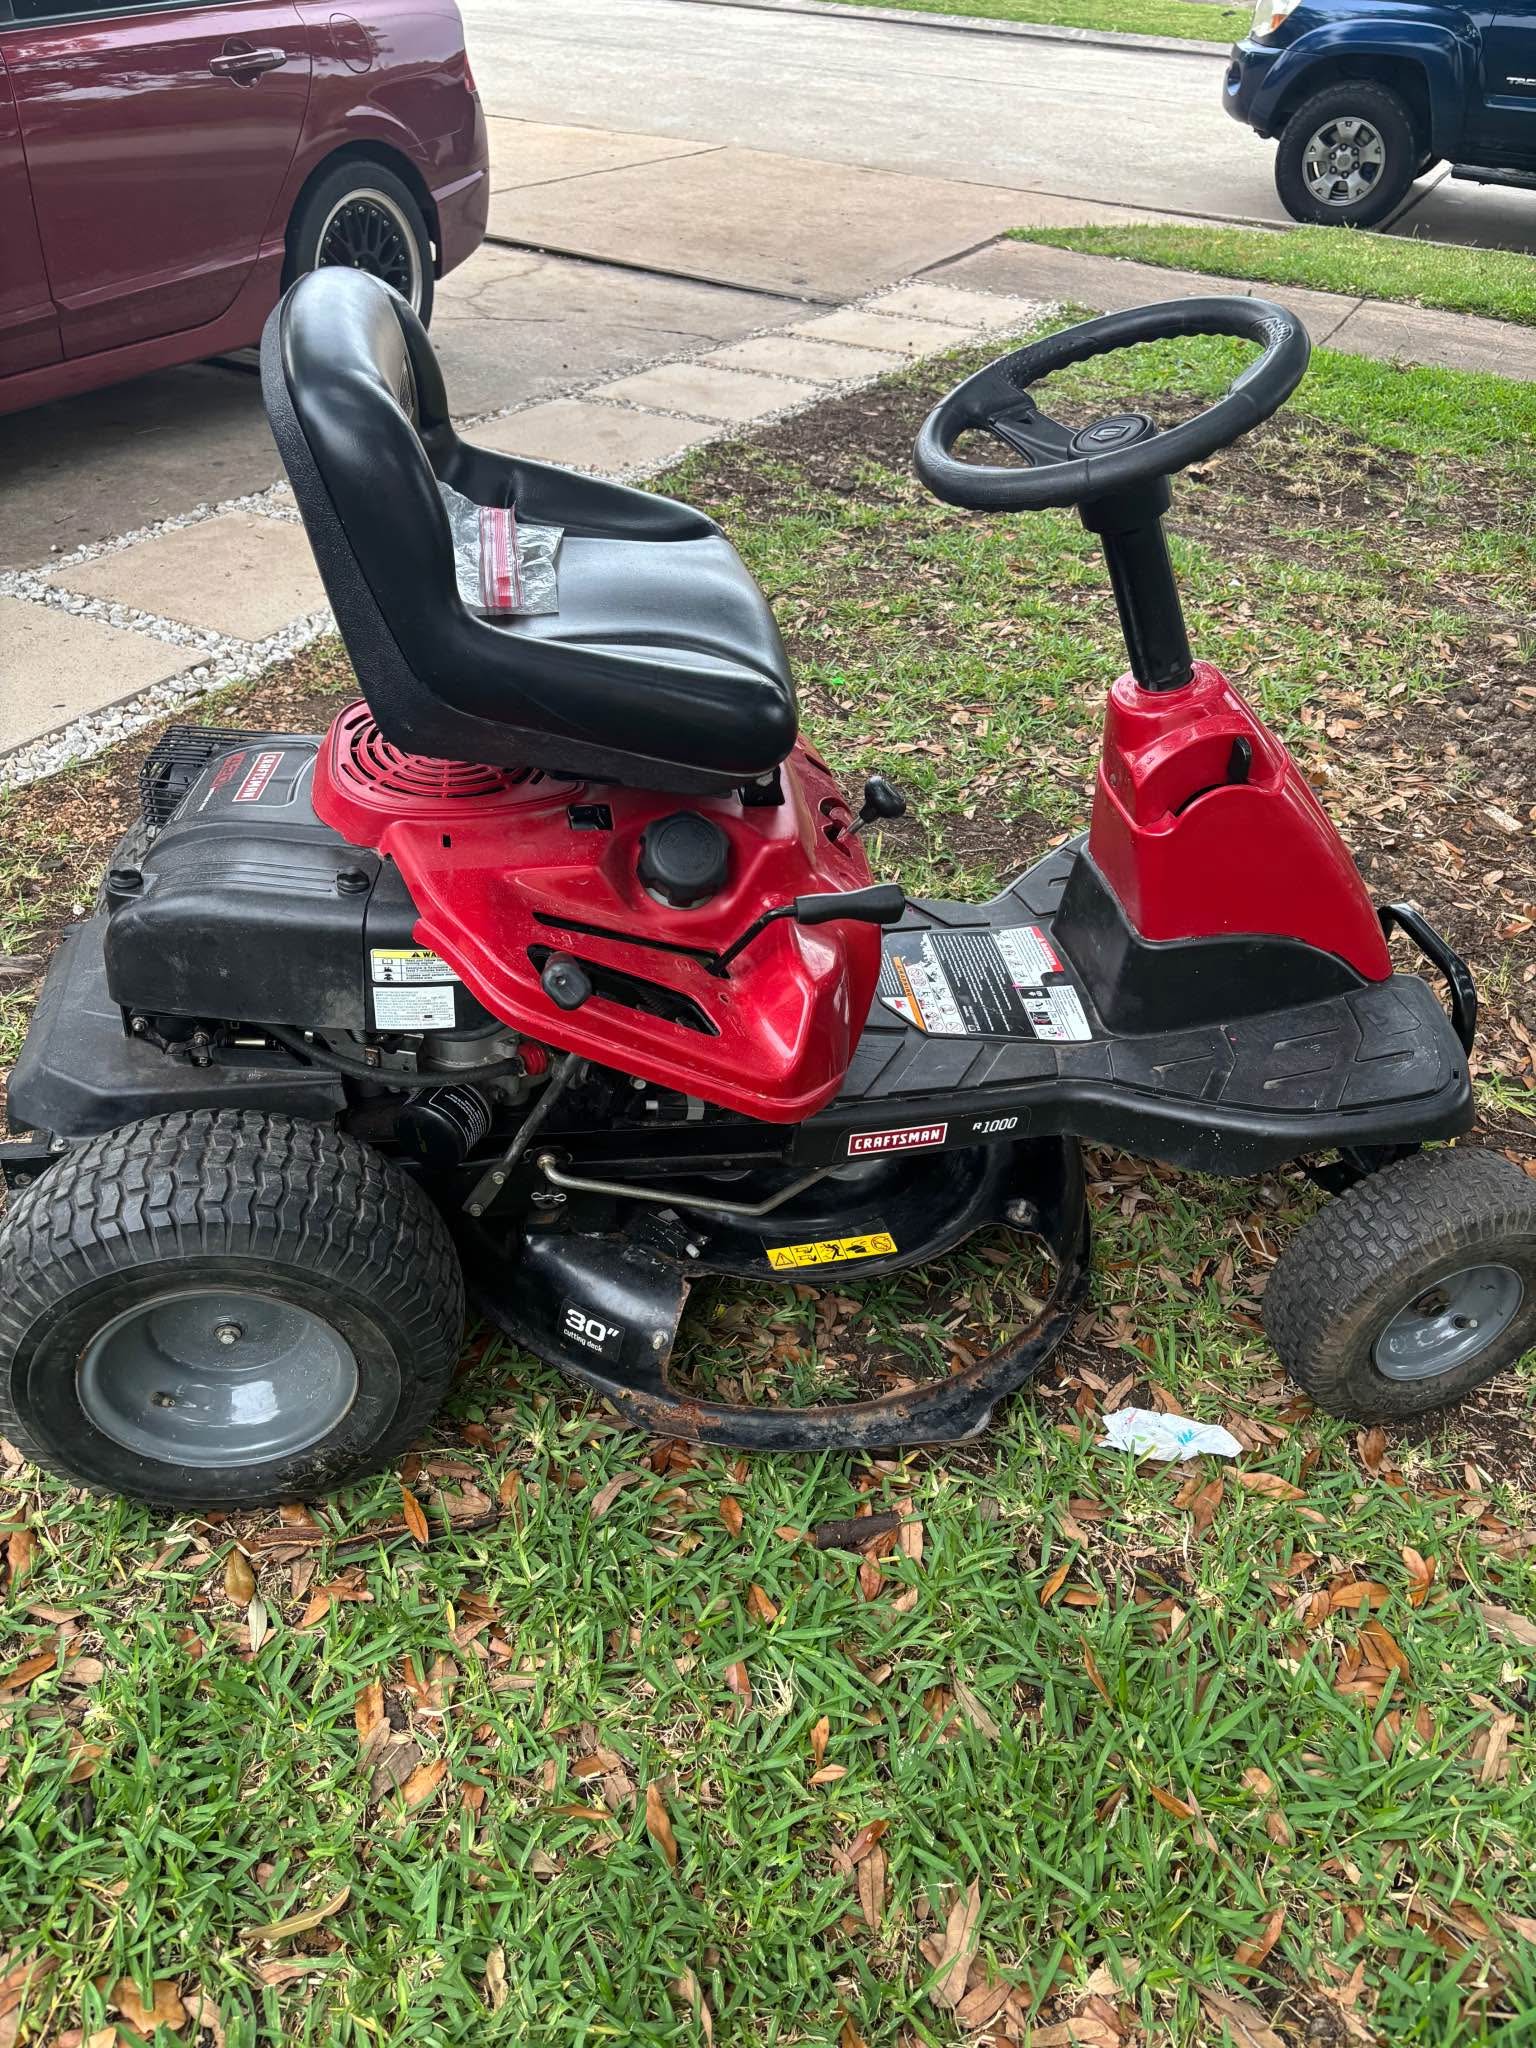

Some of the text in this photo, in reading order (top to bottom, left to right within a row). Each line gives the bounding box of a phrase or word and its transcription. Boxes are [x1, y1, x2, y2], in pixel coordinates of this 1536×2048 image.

[241, 754, 278, 799] CRAFTSMAN
[854, 1116, 1018, 1150] CRAFTSMAN R1000
[563, 1328, 603, 1353] cutting deck
[565, 1308, 620, 1342] 30"
